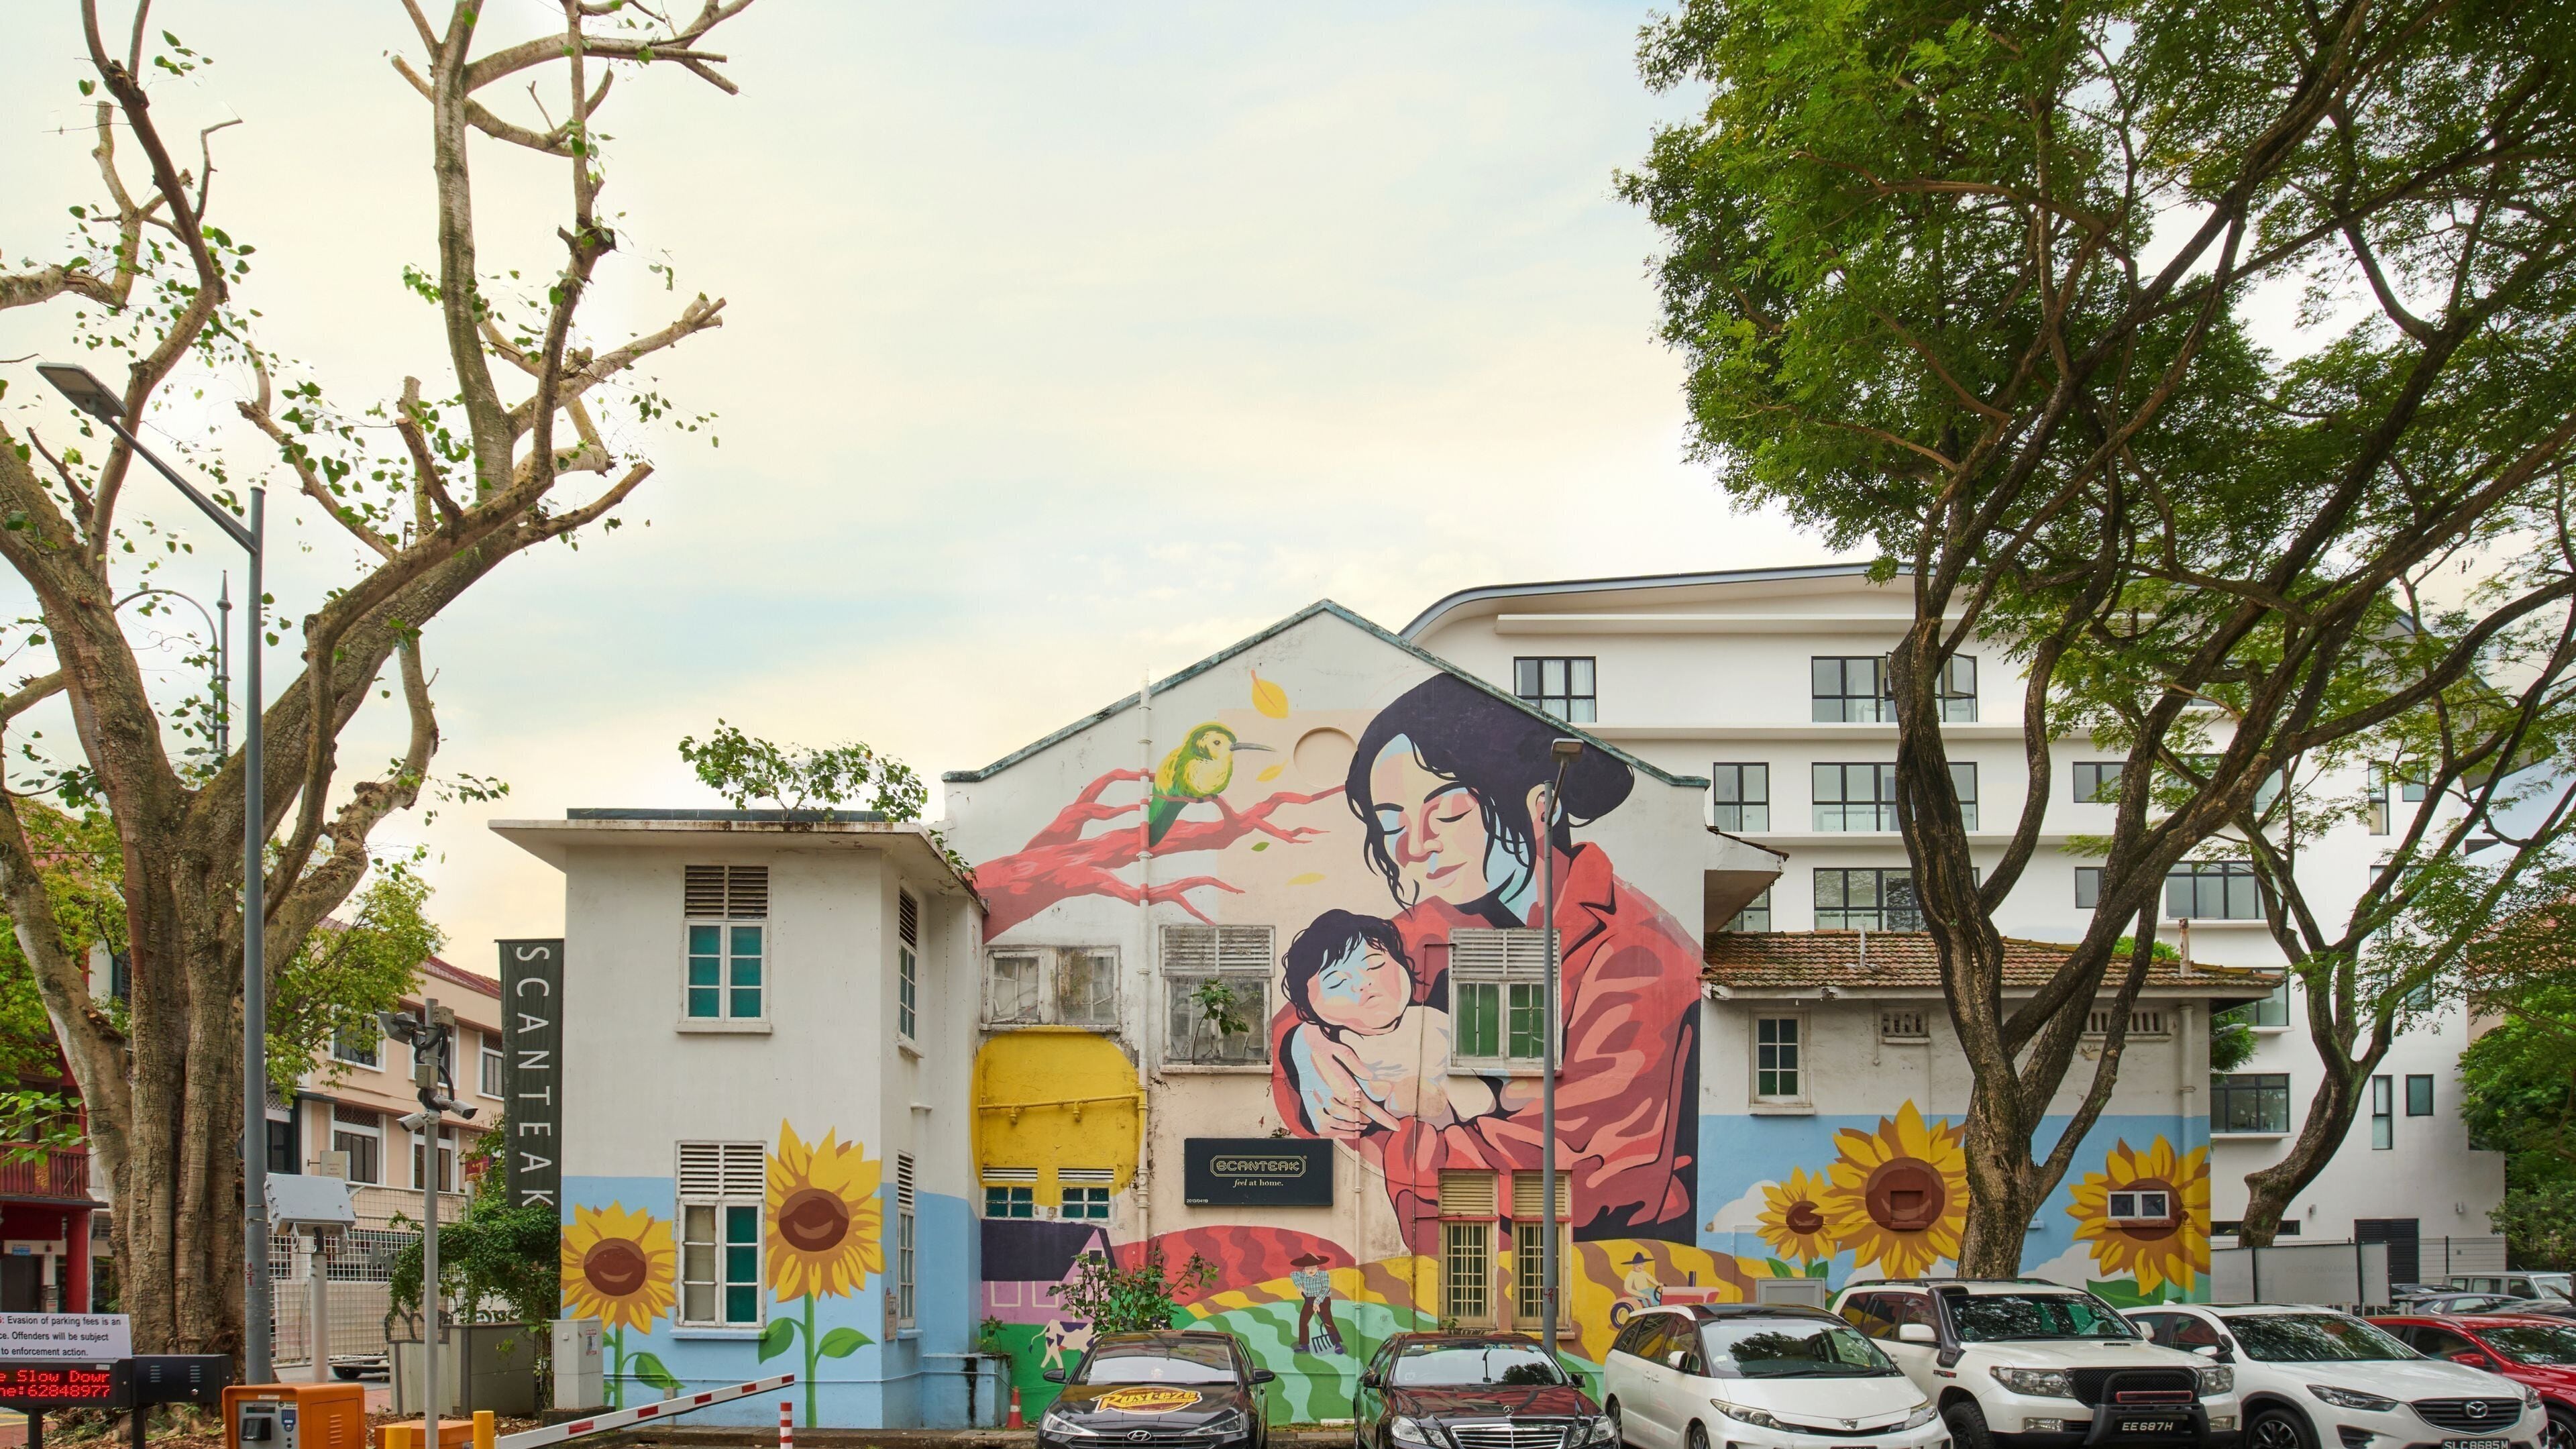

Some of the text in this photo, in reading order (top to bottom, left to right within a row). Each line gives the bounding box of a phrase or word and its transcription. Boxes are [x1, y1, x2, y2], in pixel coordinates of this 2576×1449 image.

[516, 946, 554, 1207] SCANTEAK
[1216, 1161, 1299, 1171] SCANTEAK
[1232, 1179, 1248, 1188] feel
[7, 1316, 38, 1325] Evasion
[40, 1316, 49, 1325] of
[51, 1316, 80, 1327] parking
[83, 1317, 99, 1326] fees
[102, 1318, 109, 1326] is
[11, 1331, 50, 1340] Offenders
[52, 1332, 66, 1340] will
[68, 1332, 78, 1341] be
[80, 1333, 109, 1342] subject
[1, 1347, 89, 1356] to enforcement action.
[17, 1370, 60, 1383] Slow
[2121, 1421, 2174, 1431] EE687H
